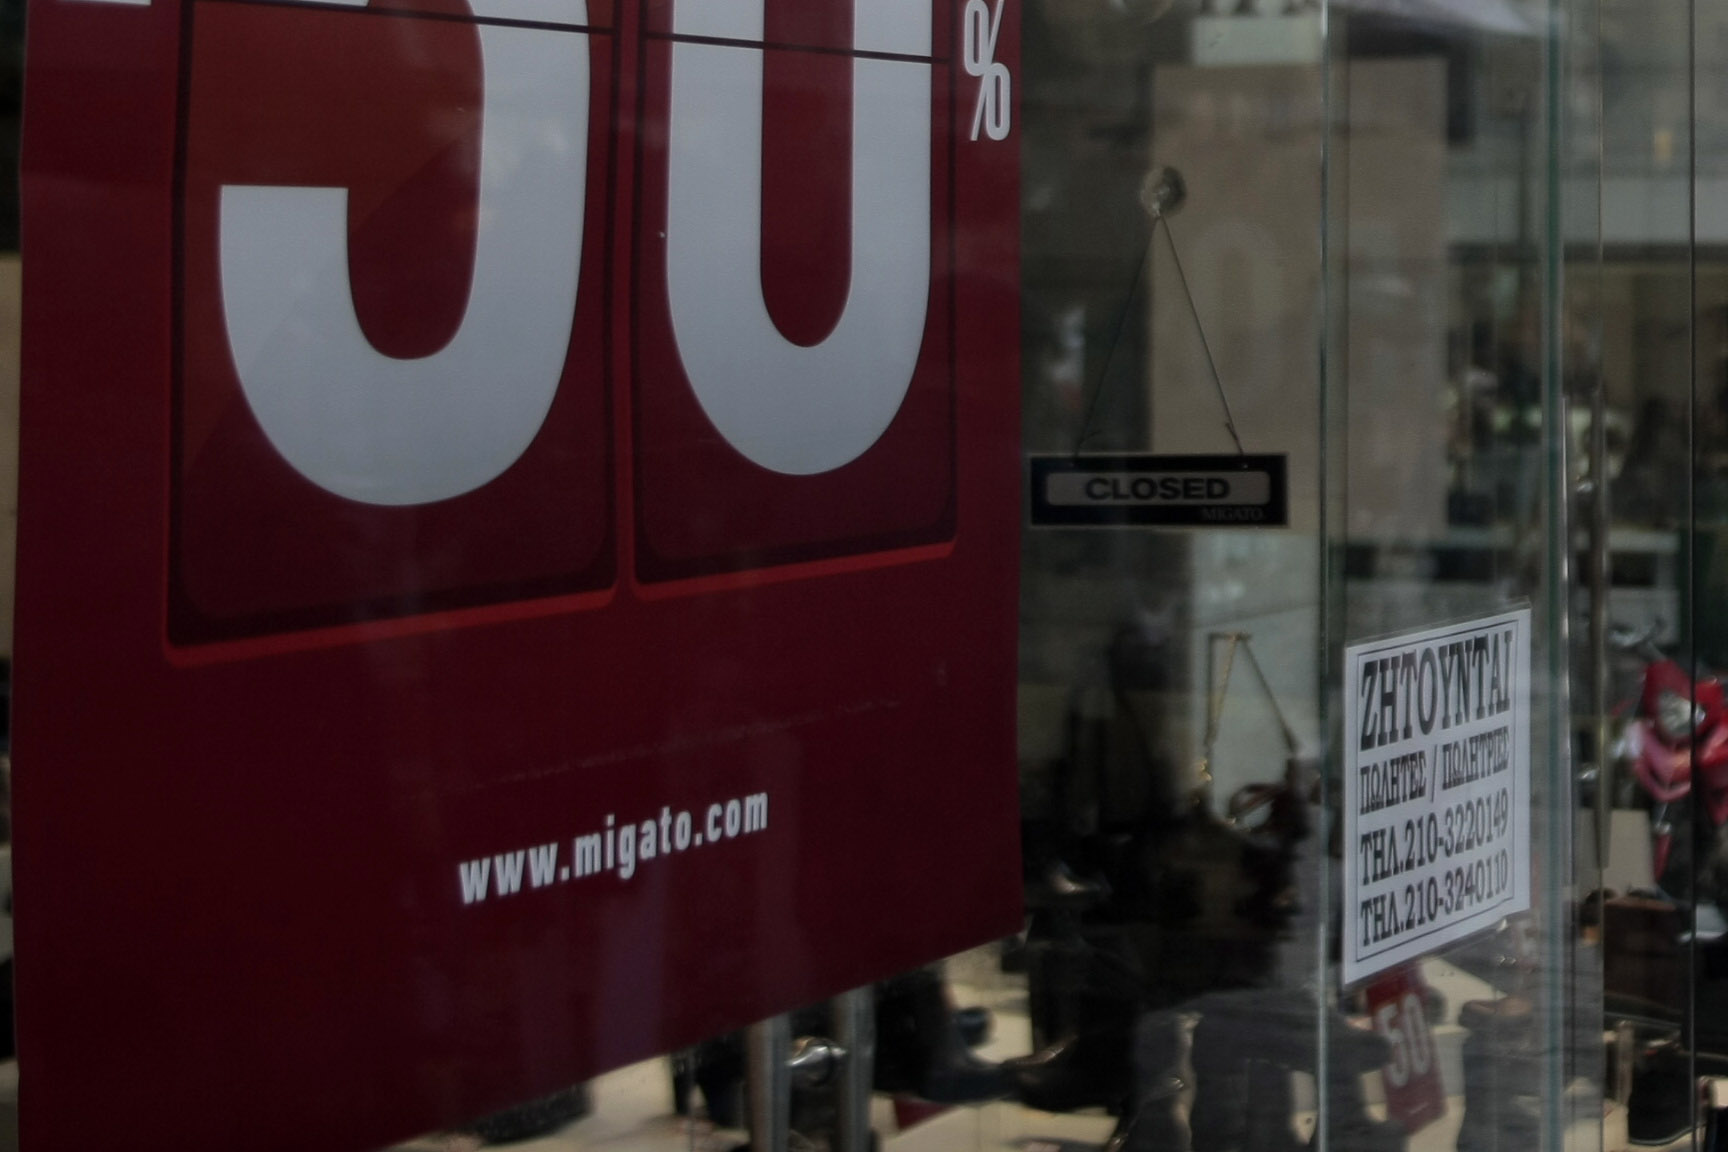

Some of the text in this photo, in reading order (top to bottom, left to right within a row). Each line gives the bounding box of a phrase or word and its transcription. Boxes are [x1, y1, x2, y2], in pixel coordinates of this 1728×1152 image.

[1084, 476, 1231, 501] CLOSED
[1201, 506, 1264, 522] MIGATO
[1360, 631, 1512, 749] ΖΗΤΟΥΝΤΑΙ
[1359, 748, 1427, 816] ΠΩΛΗΤΕΣ
[458, 791, 769, 905] www.migato.com
